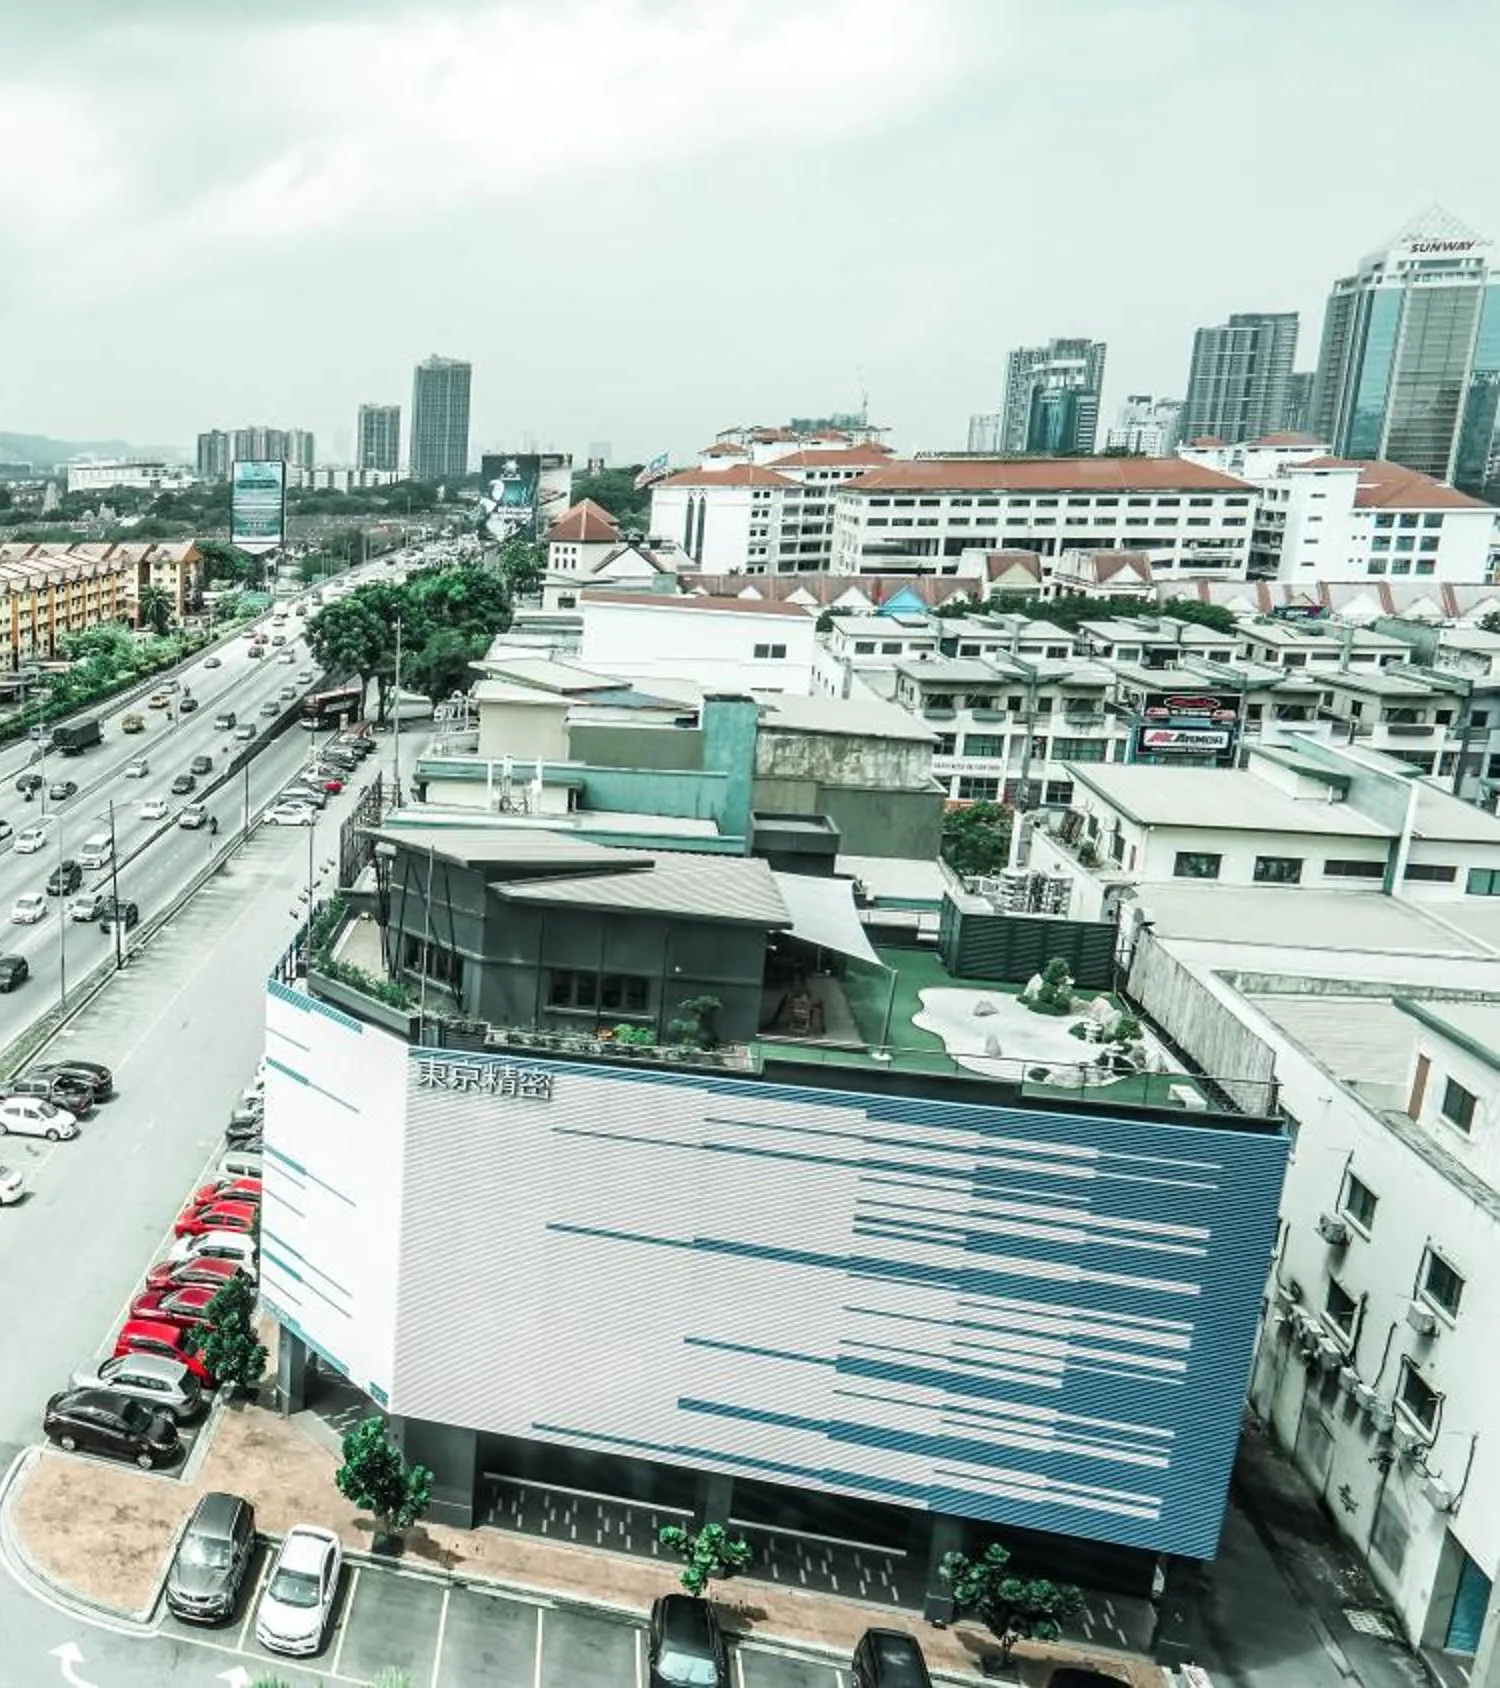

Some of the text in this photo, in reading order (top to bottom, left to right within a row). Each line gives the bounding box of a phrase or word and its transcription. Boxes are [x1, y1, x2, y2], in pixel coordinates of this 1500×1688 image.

[1410, 240, 1476, 253] SUNWAY
[417, 1056, 553, 1101] 東京精密
